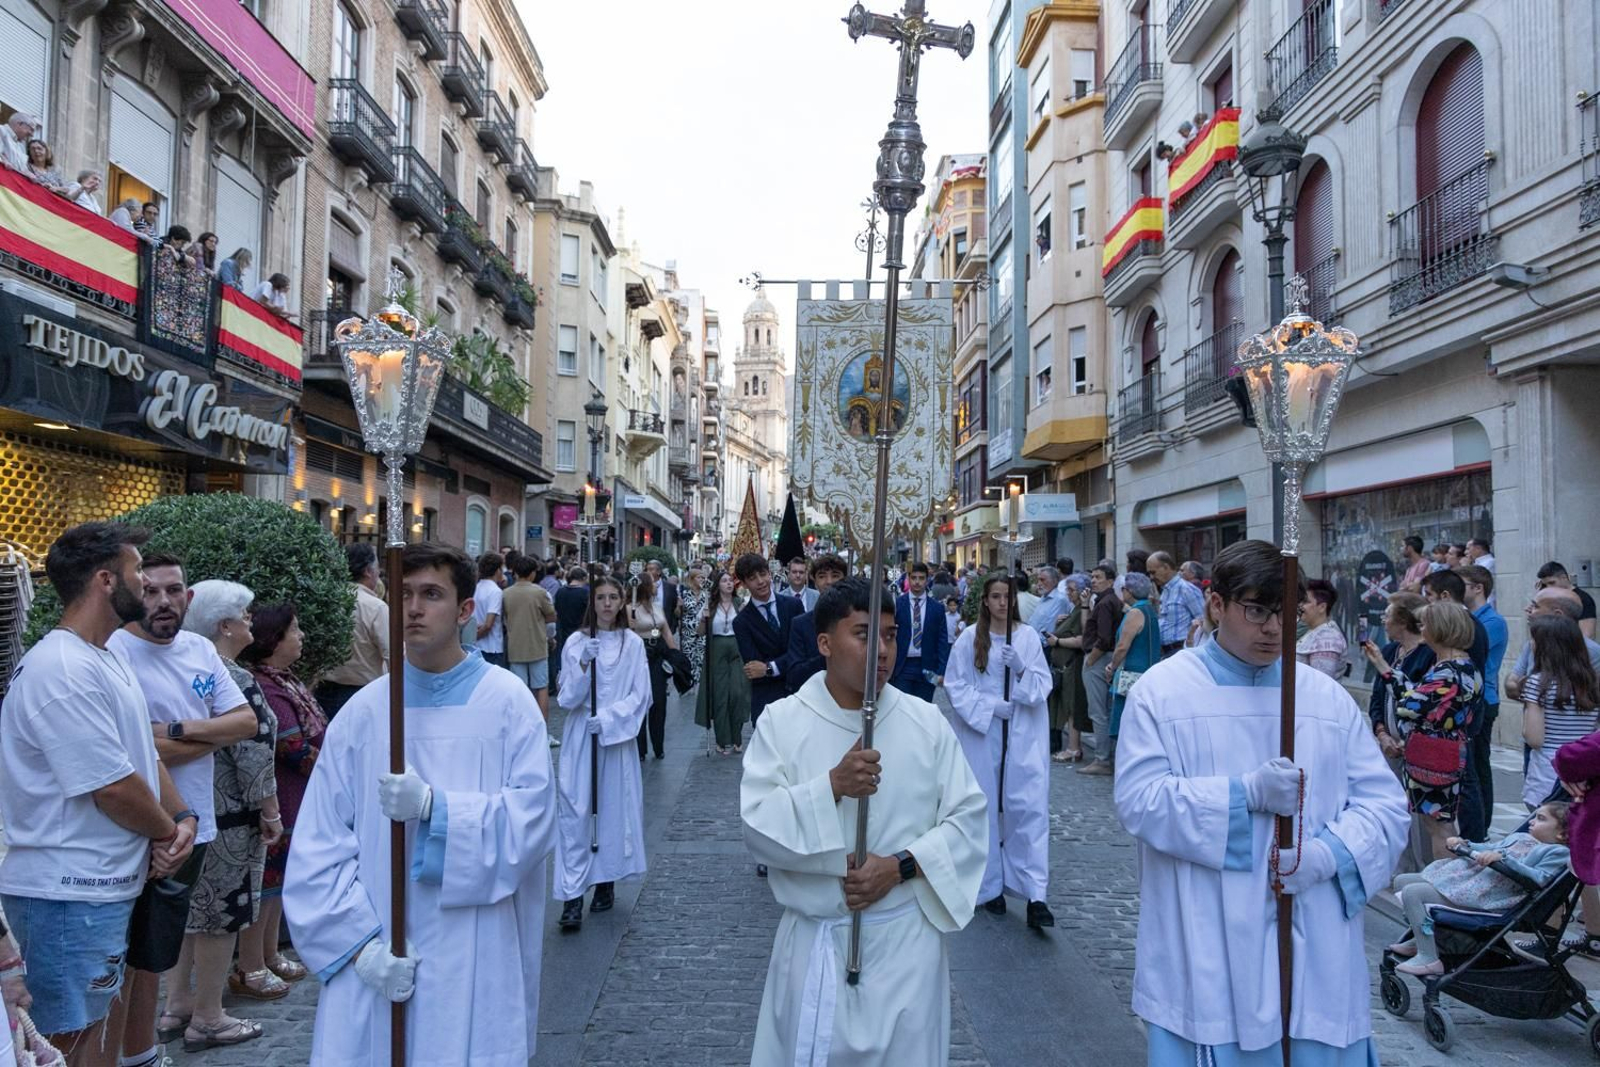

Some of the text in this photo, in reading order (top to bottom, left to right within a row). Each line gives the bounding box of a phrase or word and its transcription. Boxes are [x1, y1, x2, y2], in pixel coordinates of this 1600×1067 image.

[23, 314, 145, 381] TEJIDOS
[146, 369, 288, 450] El Carmen
[61, 876, 72, 885] DO
[73, 877, 96, 887] THINGS
[98, 878, 112, 887] THAT
